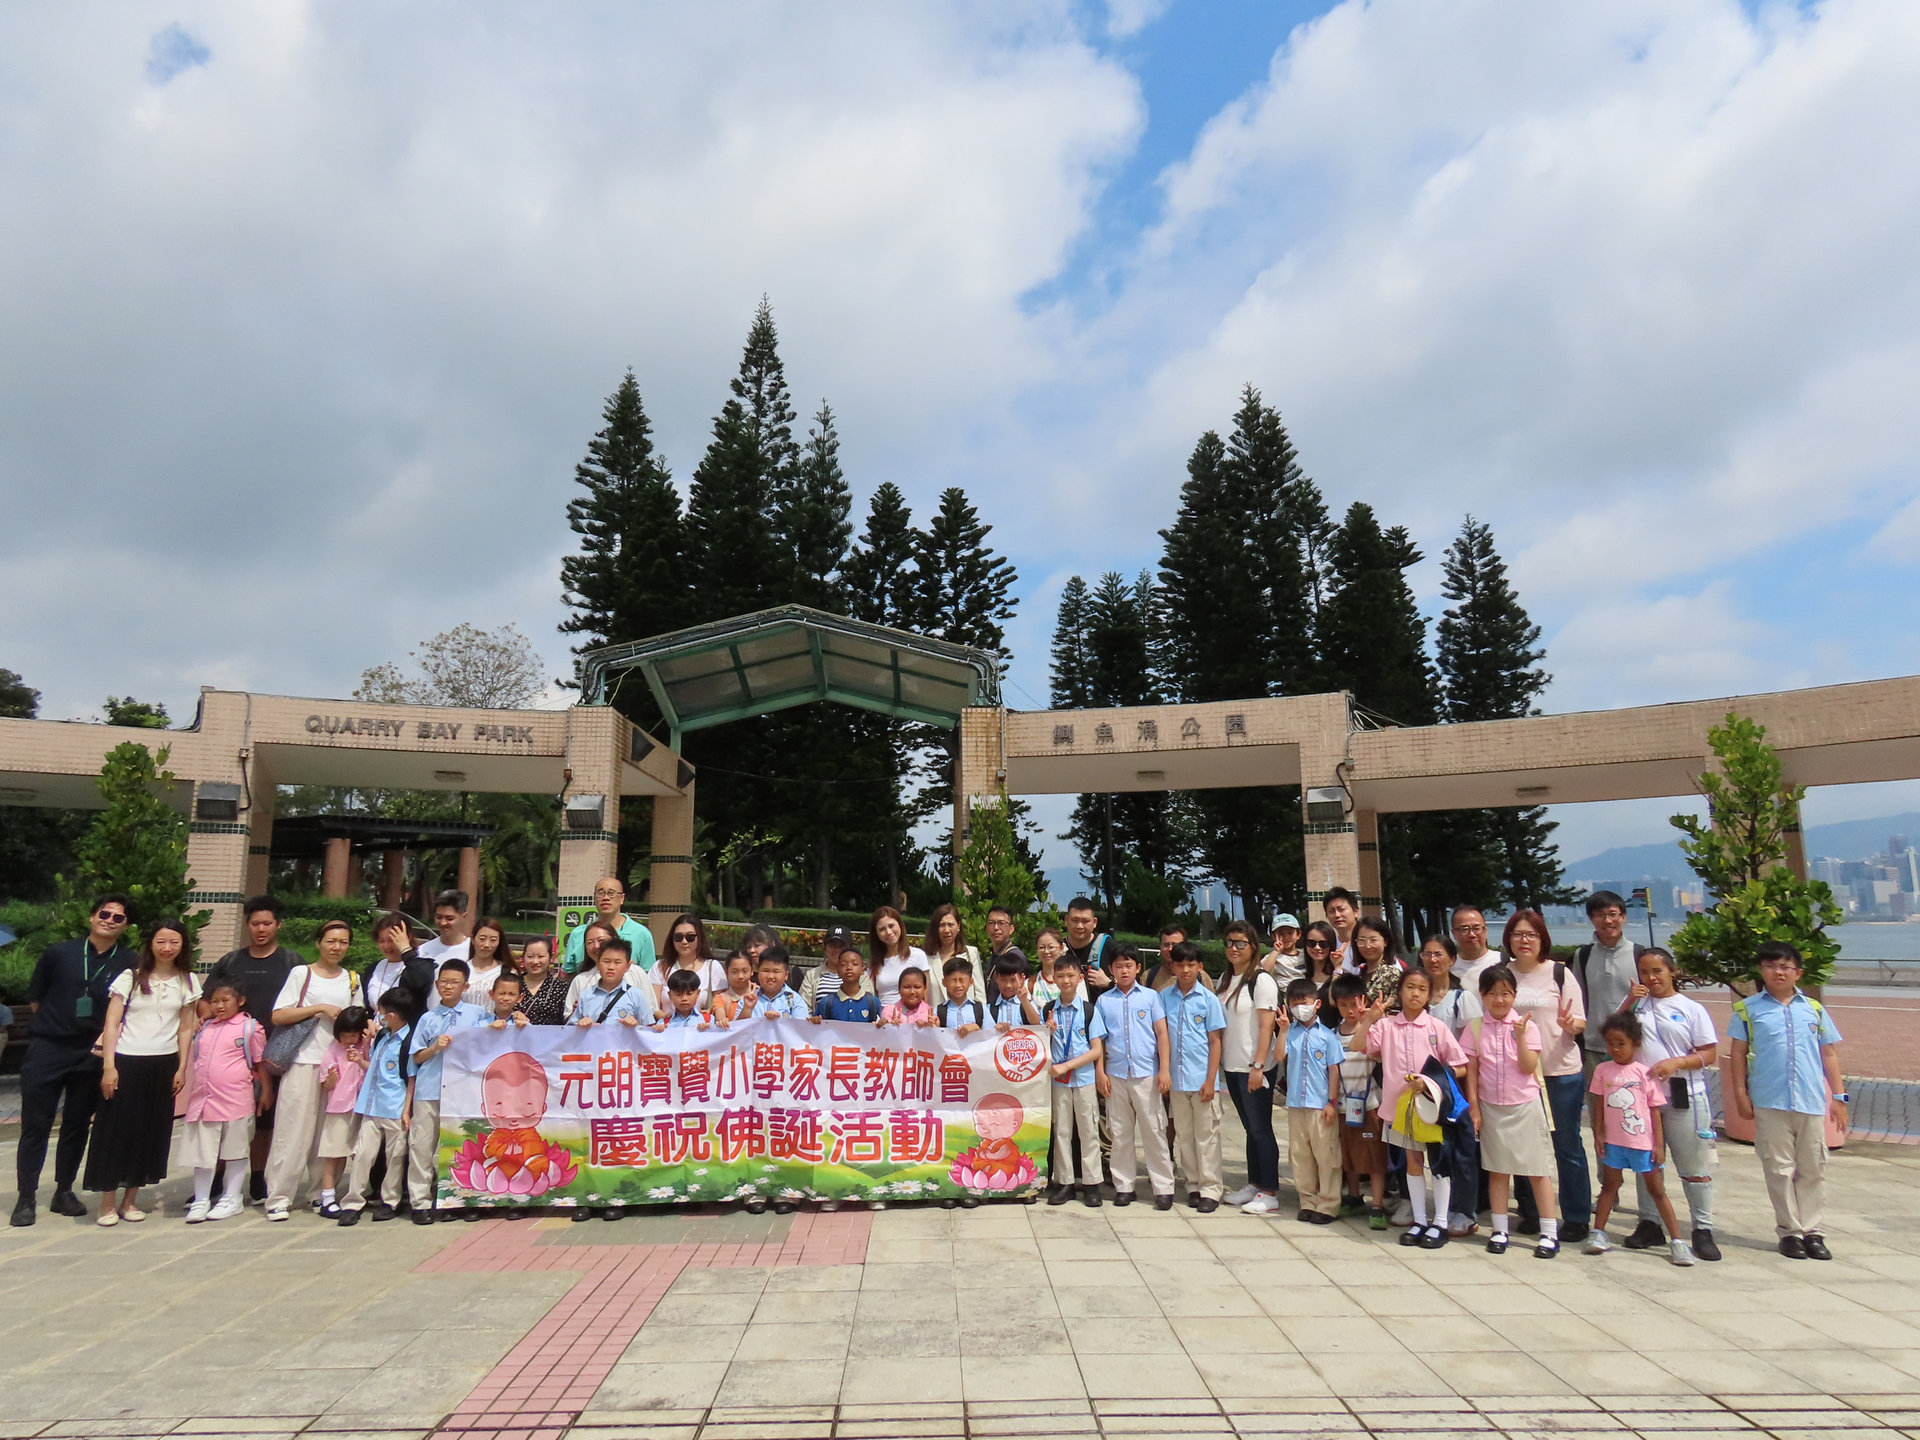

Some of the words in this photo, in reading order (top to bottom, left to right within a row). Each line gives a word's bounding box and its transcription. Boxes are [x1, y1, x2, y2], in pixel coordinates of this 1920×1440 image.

[305, 714, 405, 737] QUARRY
[417, 721, 463, 739] BAY
[474, 724, 534, 743] PARK
[1052, 714, 1248, 744] 鰂魚涌公園
[1006, 1040, 1034, 1050] YLPKPS
[1009, 1051, 1031, 1063] PTA
[559, 1042, 973, 1109] 元朗寶覺小學家長教師會
[590, 1105, 943, 1166] 慶祝佛誕活動
